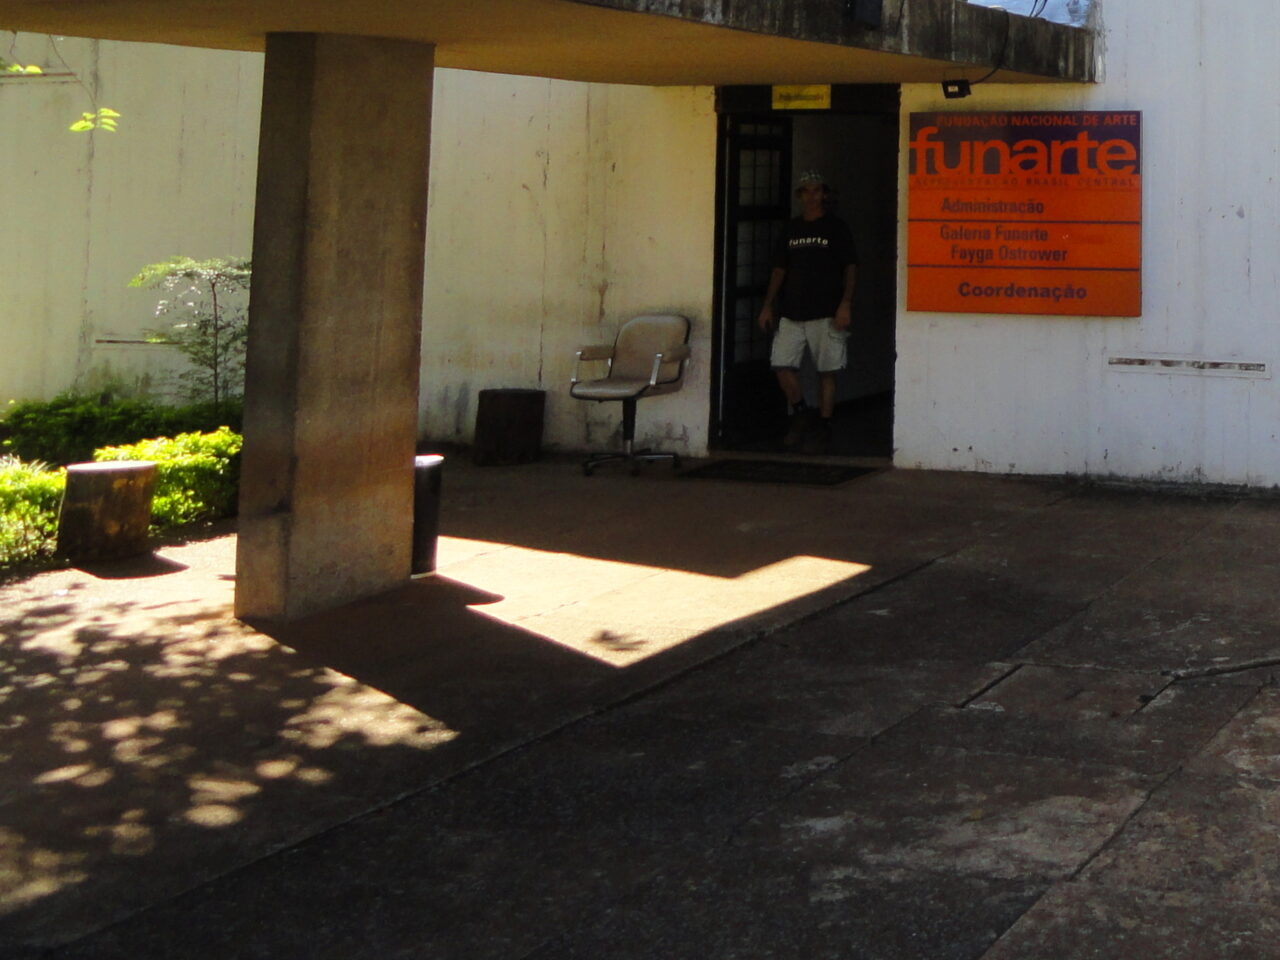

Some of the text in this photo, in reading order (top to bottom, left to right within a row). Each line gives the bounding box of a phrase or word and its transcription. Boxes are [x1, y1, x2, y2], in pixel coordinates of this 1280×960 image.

[936, 113, 1137, 128] FUNDAÇÃO NACIONAL DE ARTE
[910, 126, 1137, 175] funarte
[942, 197, 1044, 215] Administração
[940, 225, 1048, 241] Galeria Funarte
[950, 245, 1068, 263] Fayga Ostrower
[958, 282, 1087, 301] Coordenação
